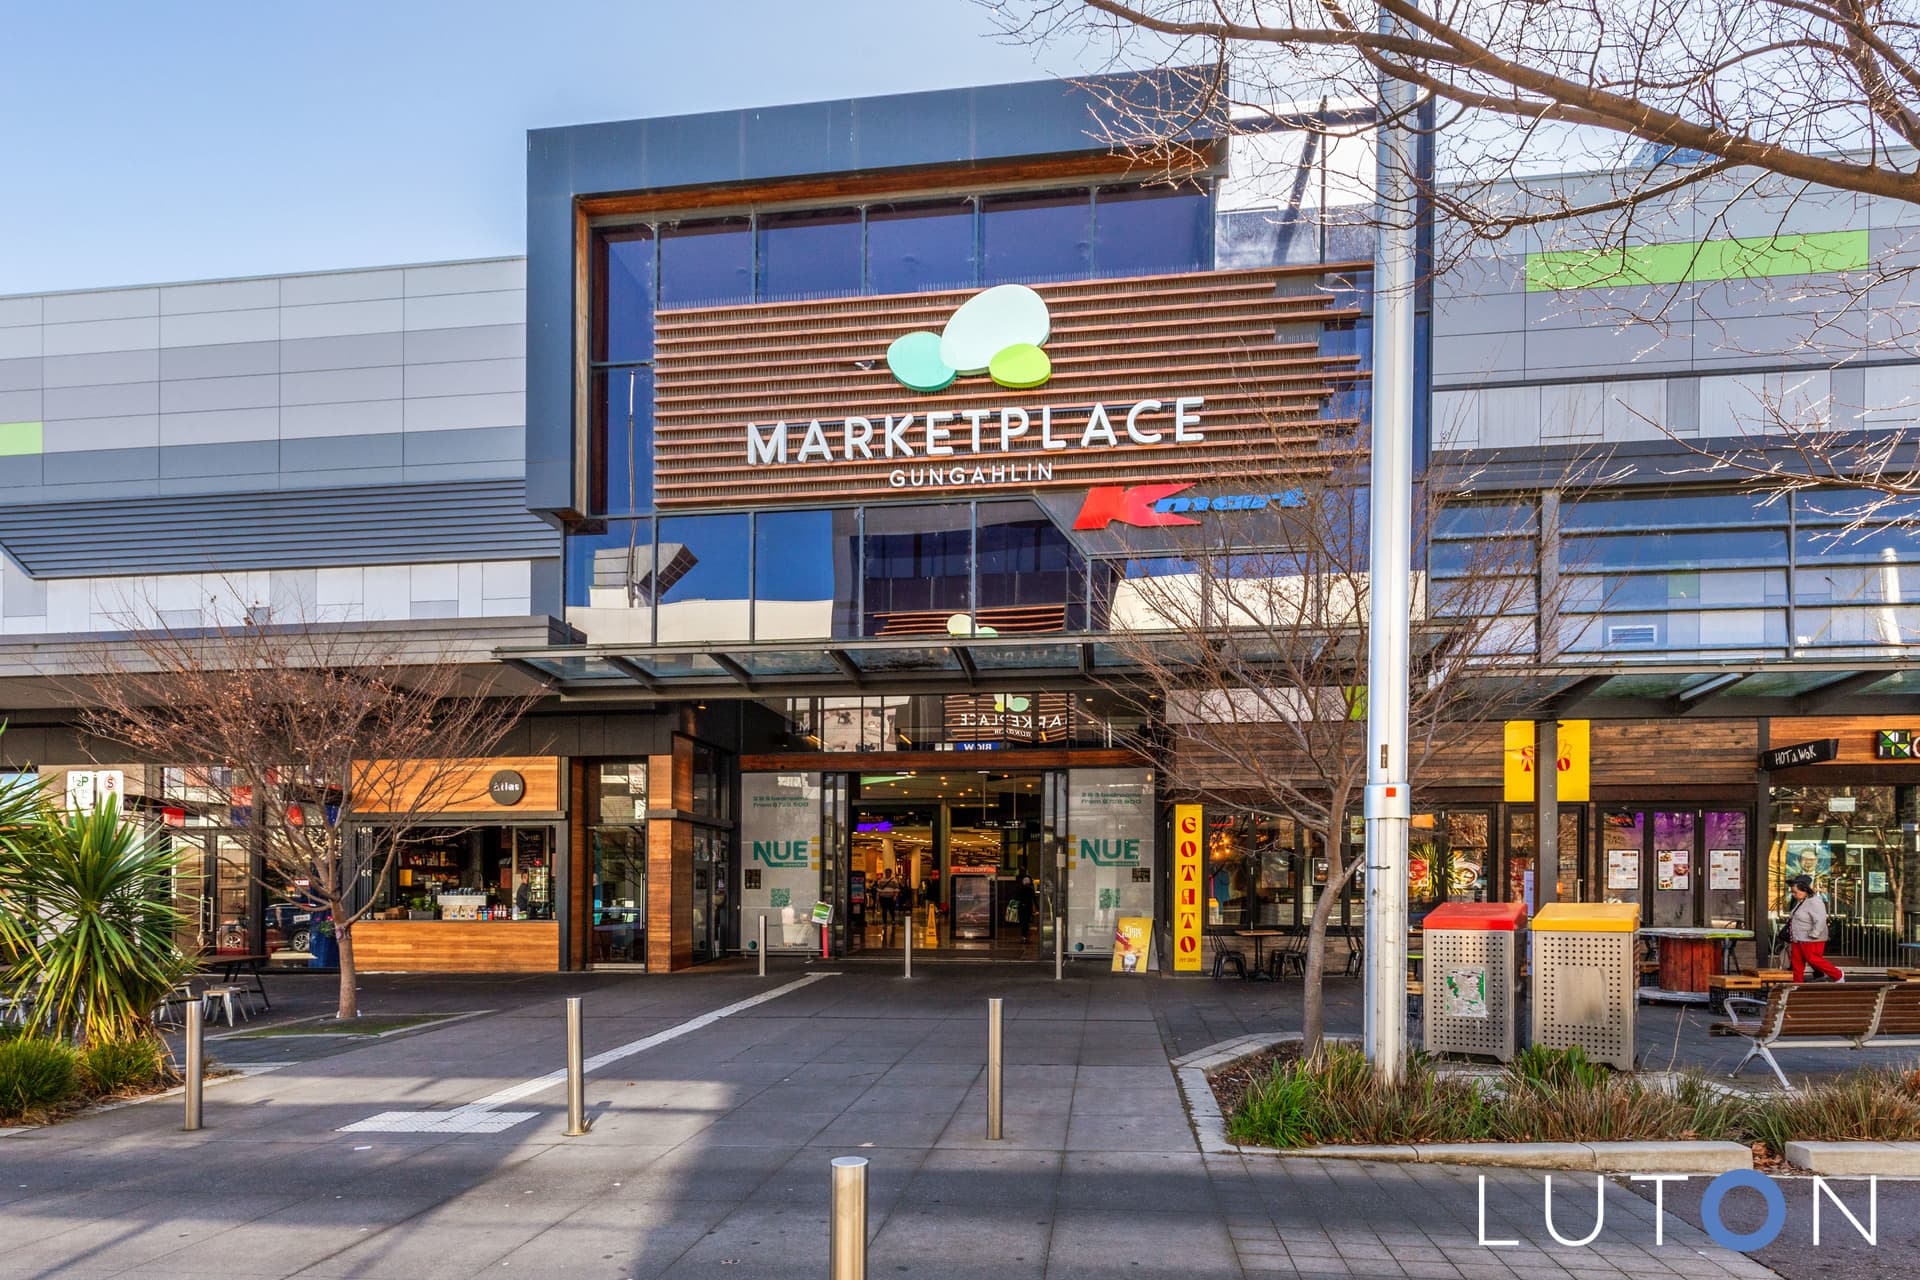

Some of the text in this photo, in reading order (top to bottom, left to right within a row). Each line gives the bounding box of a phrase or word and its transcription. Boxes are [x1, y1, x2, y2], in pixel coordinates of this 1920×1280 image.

[747, 397, 1204, 465] MARKETPLACE
[890, 462, 1053, 488] GUNGAHLIN
[1775, 750, 1792, 765] HOT
[753, 840, 808, 867] NUE
[1081, 839, 1140, 866] NUE
